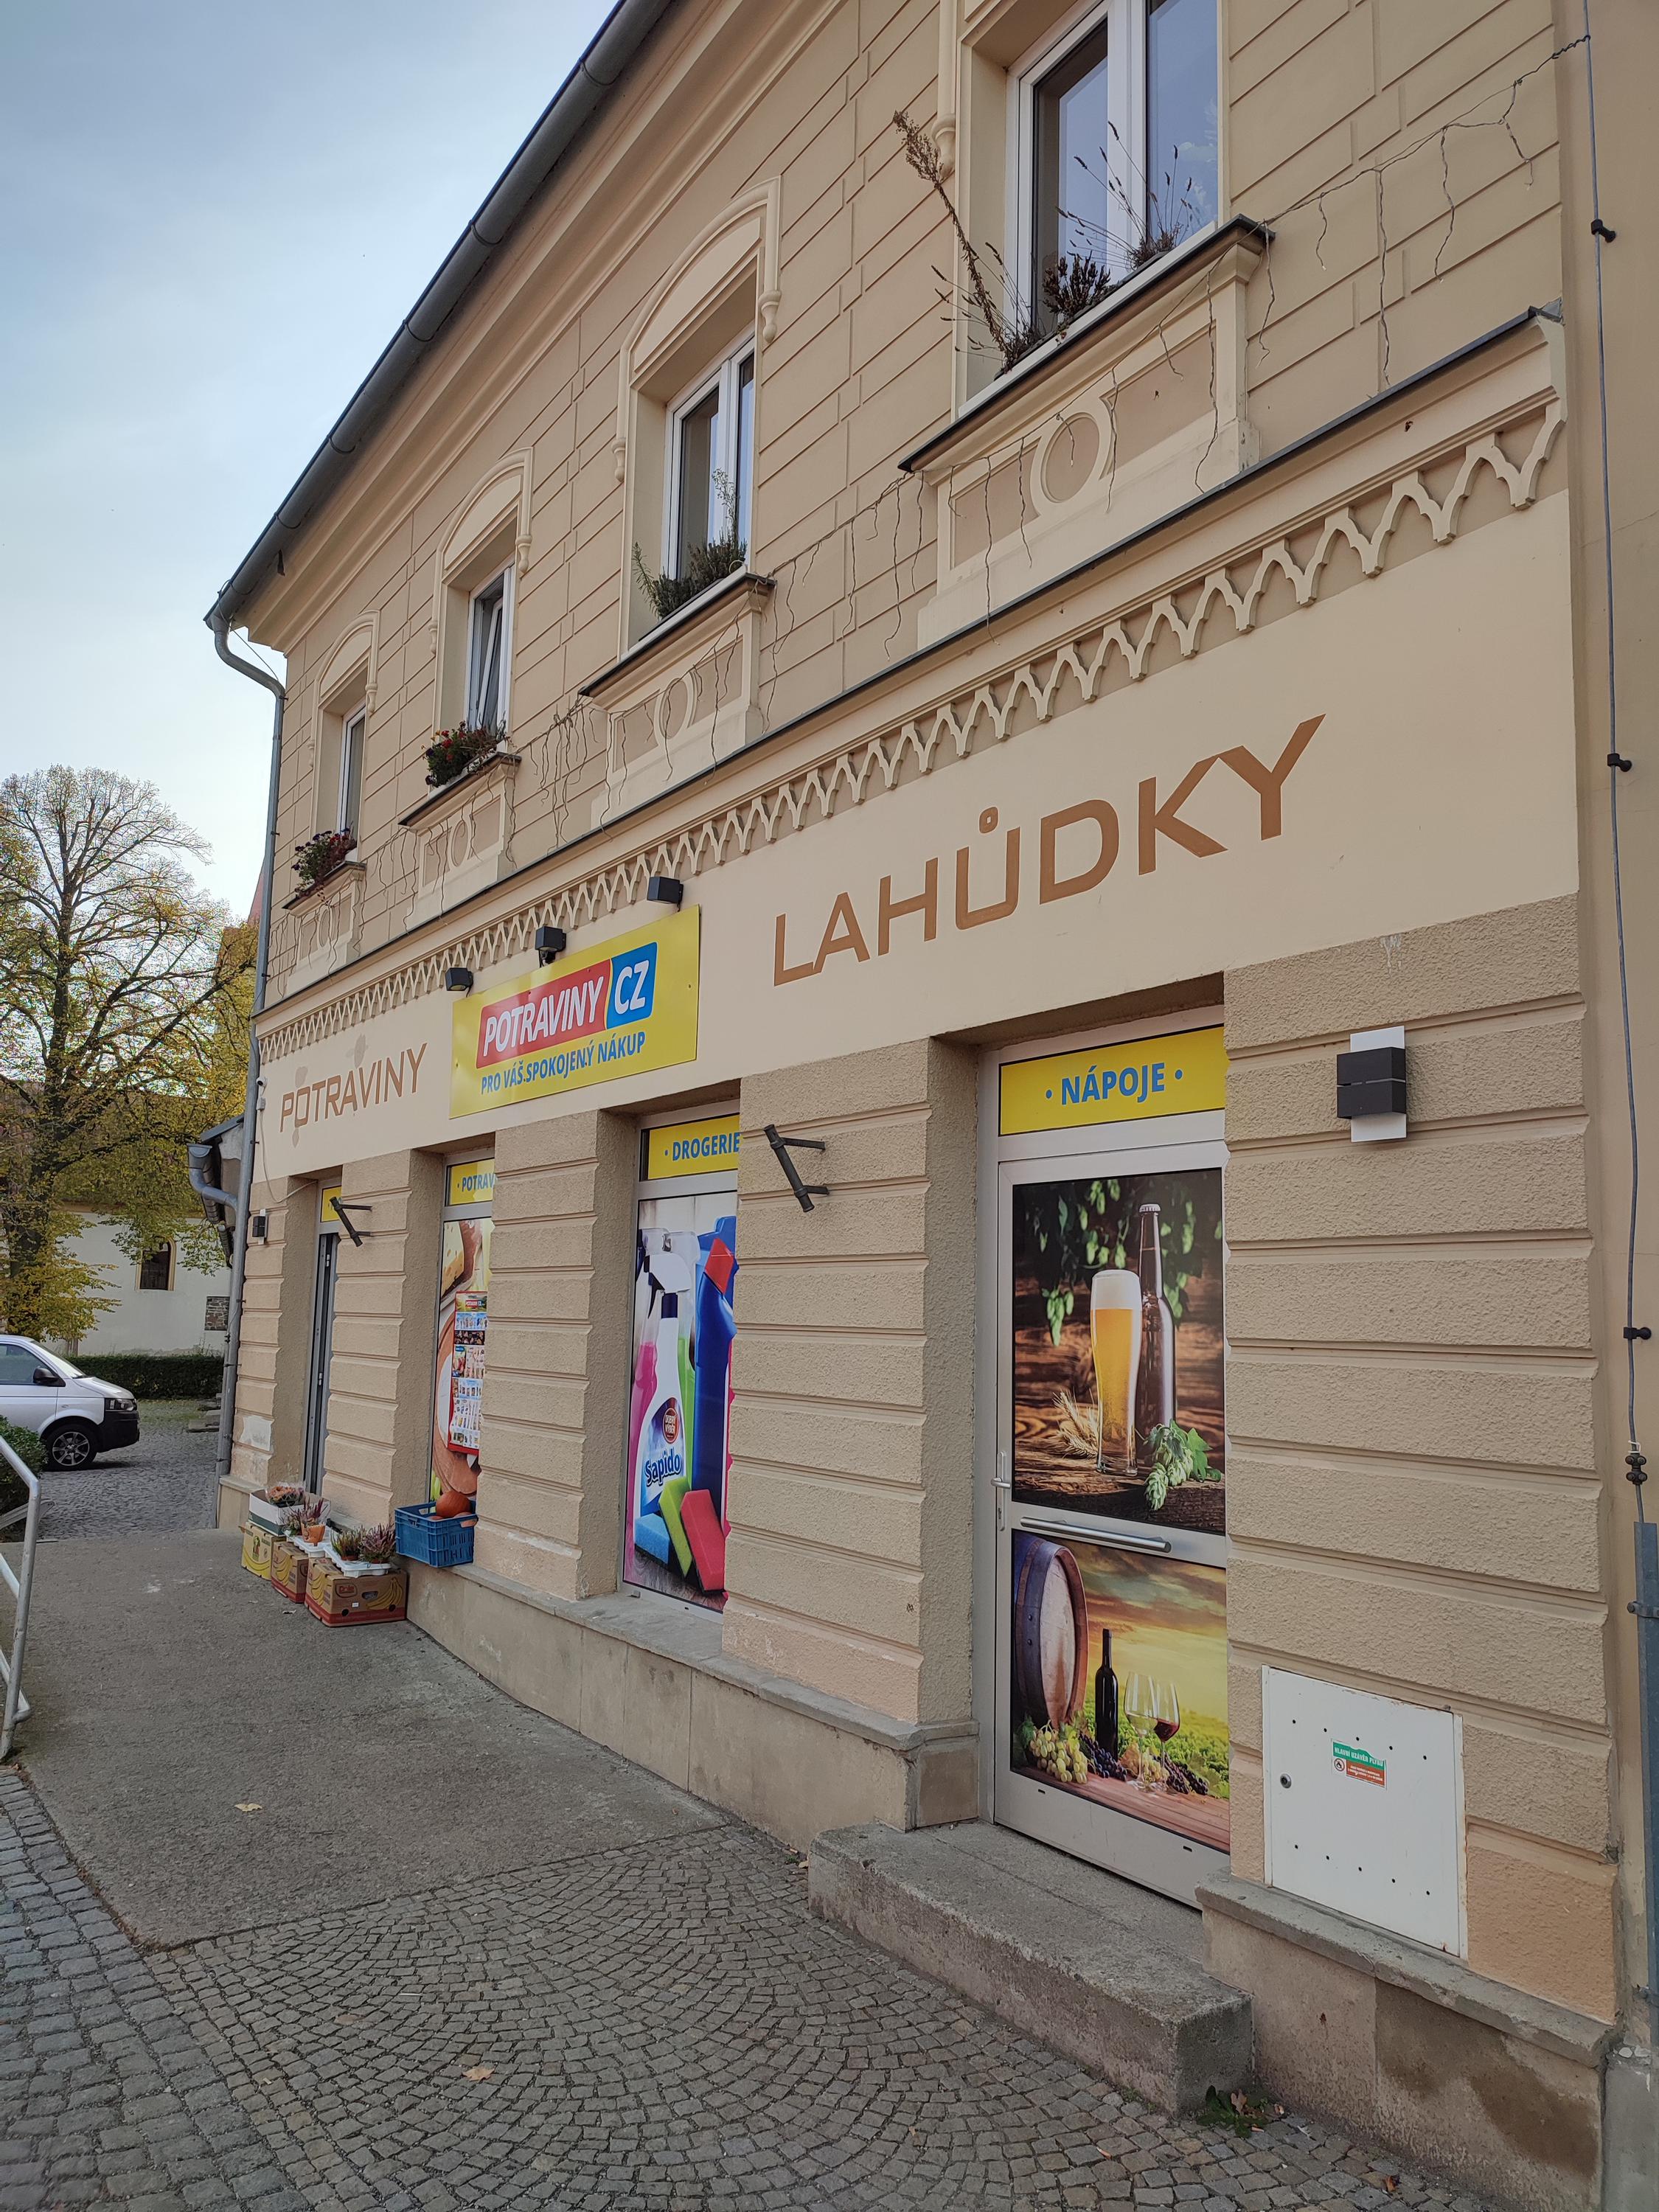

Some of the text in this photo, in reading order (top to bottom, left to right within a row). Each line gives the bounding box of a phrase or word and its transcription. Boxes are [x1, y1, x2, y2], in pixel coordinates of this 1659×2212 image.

[773, 713, 1326, 987] LAHŮDKY
[483, 959, 650, 1057] POTRAVINY CZ
[279, 1043, 428, 1133] POTRAVINY
[481, 1031, 646, 1095] PRO VÁŠ SPOKOJENÝ NÁKUP
[1061, 1062, 1165, 1105] NÁPOJE
[672, 1132, 740, 1161] DROGERIE
[645, 1448, 682, 1486] Sapido
[1334, 1747, 1351, 1757] HLAVNÍ
[1351, 1752, 1368, 1762] UZÁVĚR
